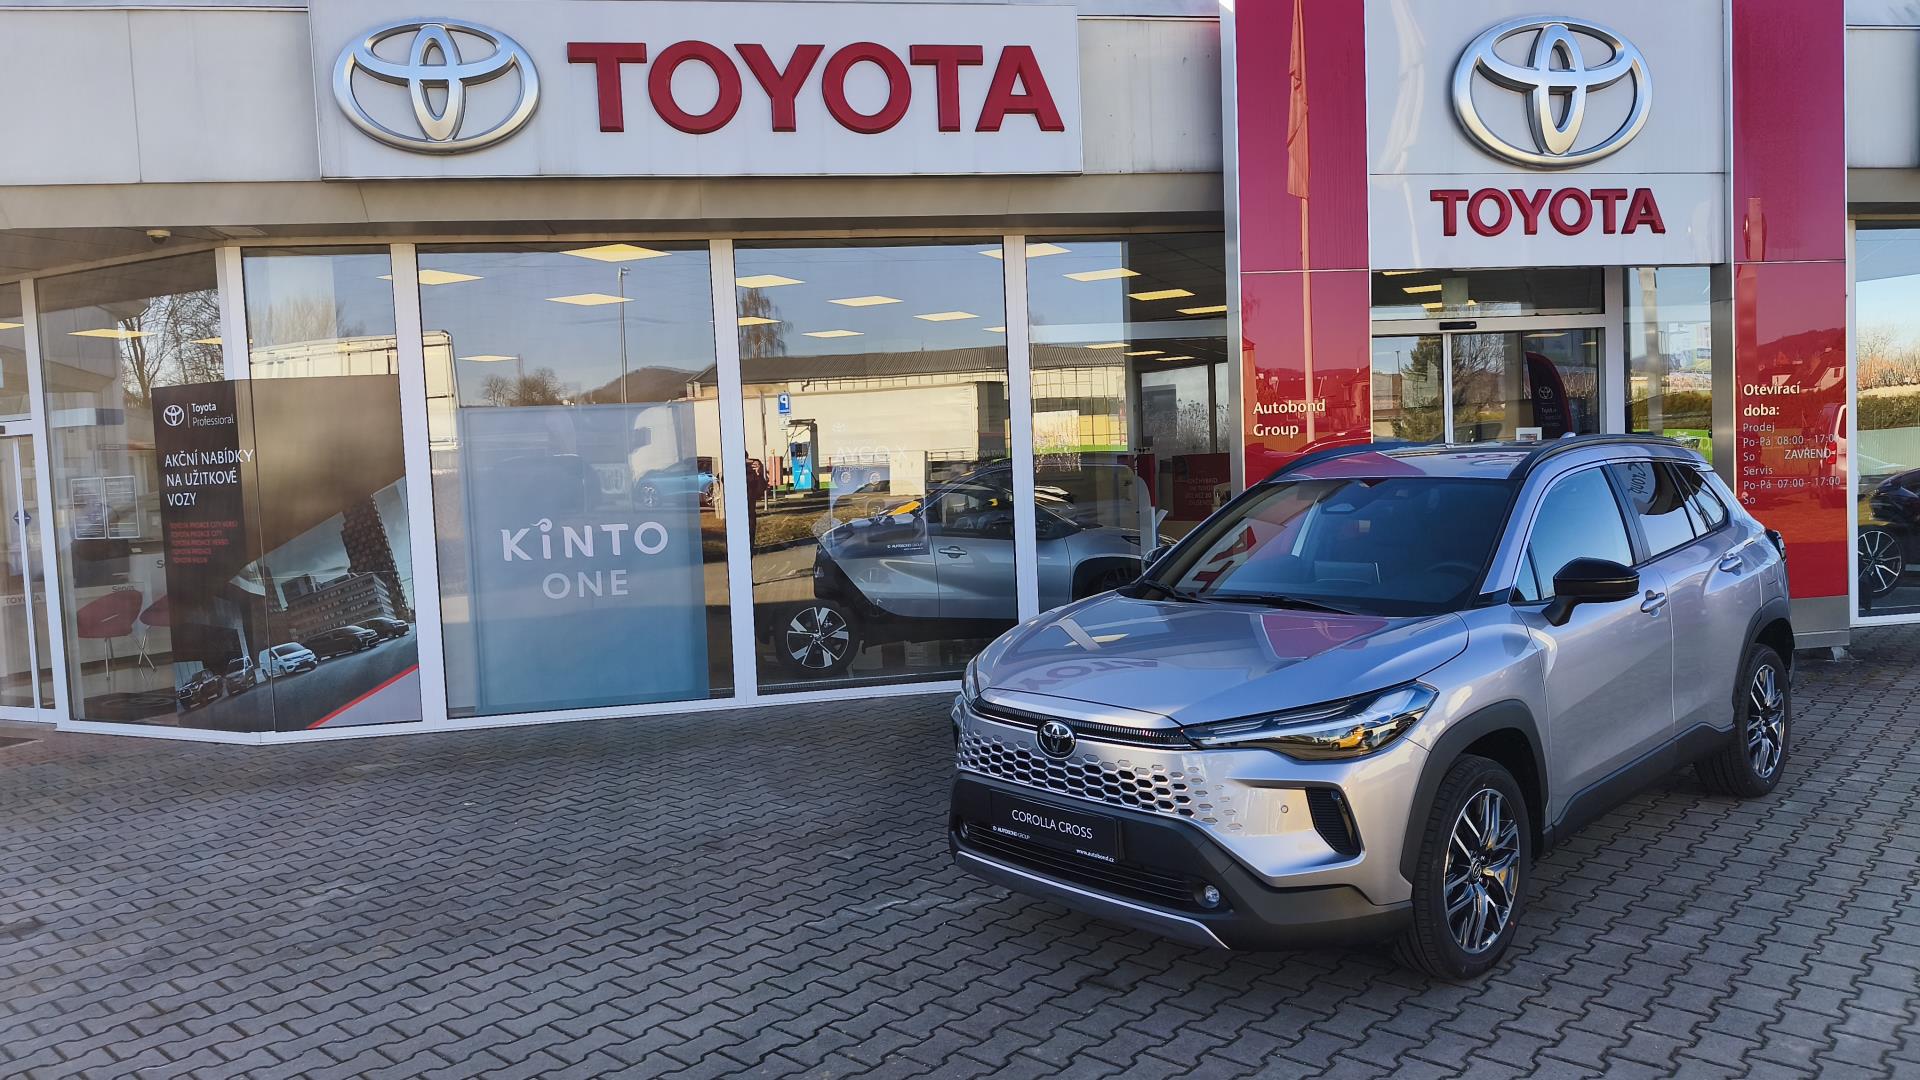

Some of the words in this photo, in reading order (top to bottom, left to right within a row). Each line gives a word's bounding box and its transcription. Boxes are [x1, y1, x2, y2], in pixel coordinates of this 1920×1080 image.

[567, 40, 1065, 135] TOYOTA
[1430, 187, 1666, 237] TOYOTA
[1743, 381, 1800, 395] Otevírací
[191, 402, 217, 414] Toyota
[1253, 398, 1325, 414] Autobond
[1744, 403, 1780, 416] doba:
[192, 413, 234, 426] Professional
[1253, 423, 1299, 439] Group
[1743, 421, 1775, 433] Prodej
[1743, 436, 1771, 447] Po-Pá
[1777, 435, 1804, 445] 08:00
[165, 449, 198, 467] AKČNÍ
[201, 447, 254, 465] NABÍDKY
[1743, 451, 1755, 461] So
[1784, 448, 1831, 460] ZAVŘENO
[166, 473, 182, 487] NA
[184, 467, 238, 486] UŽITKOVÉ
[1743, 465, 1773, 476] Servis
[1743, 479, 1771, 490] Po-Pá
[1777, 478, 1804, 488] 07:00
[1815, 476, 1840, 486] 17:00
[167, 491, 197, 506] VOZY
[542, 569, 629, 599] ONE
[1011, 809, 1057, 831] COROLLA
[1058, 821, 1093, 839] CROSS
